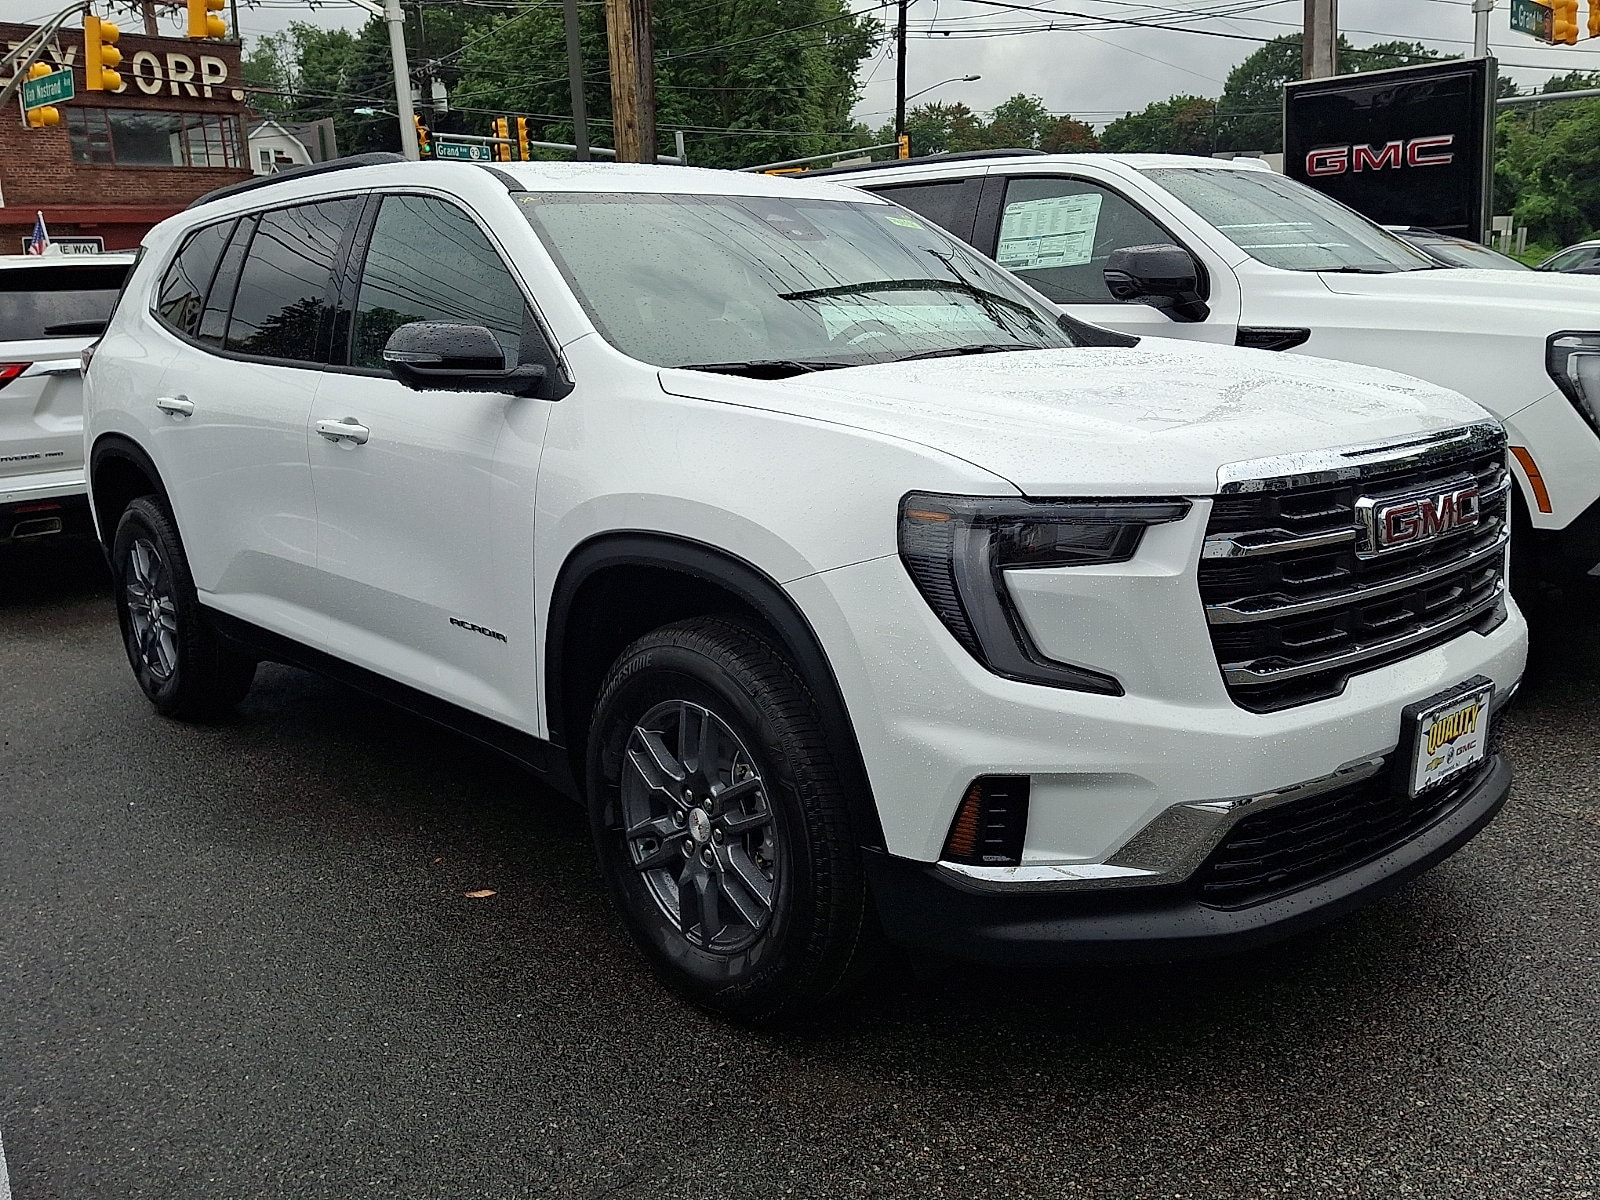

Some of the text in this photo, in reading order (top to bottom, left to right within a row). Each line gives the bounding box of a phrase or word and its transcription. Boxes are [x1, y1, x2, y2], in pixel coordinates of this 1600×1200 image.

[37, 79, 61, 99] Nostrand
[110, 51, 245, 101] ORP.
[438, 145, 460, 156] Grand
[470, 148, 479, 157] 93
[1306, 134, 1455, 177] GMC
[73, 245, 94, 254] WAY
[1379, 488, 1479, 546] GMC
[449, 617, 508, 643] ACADIA
[1427, 703, 1480, 756] QUALITY
[1456, 740, 1477, 756] GMC
